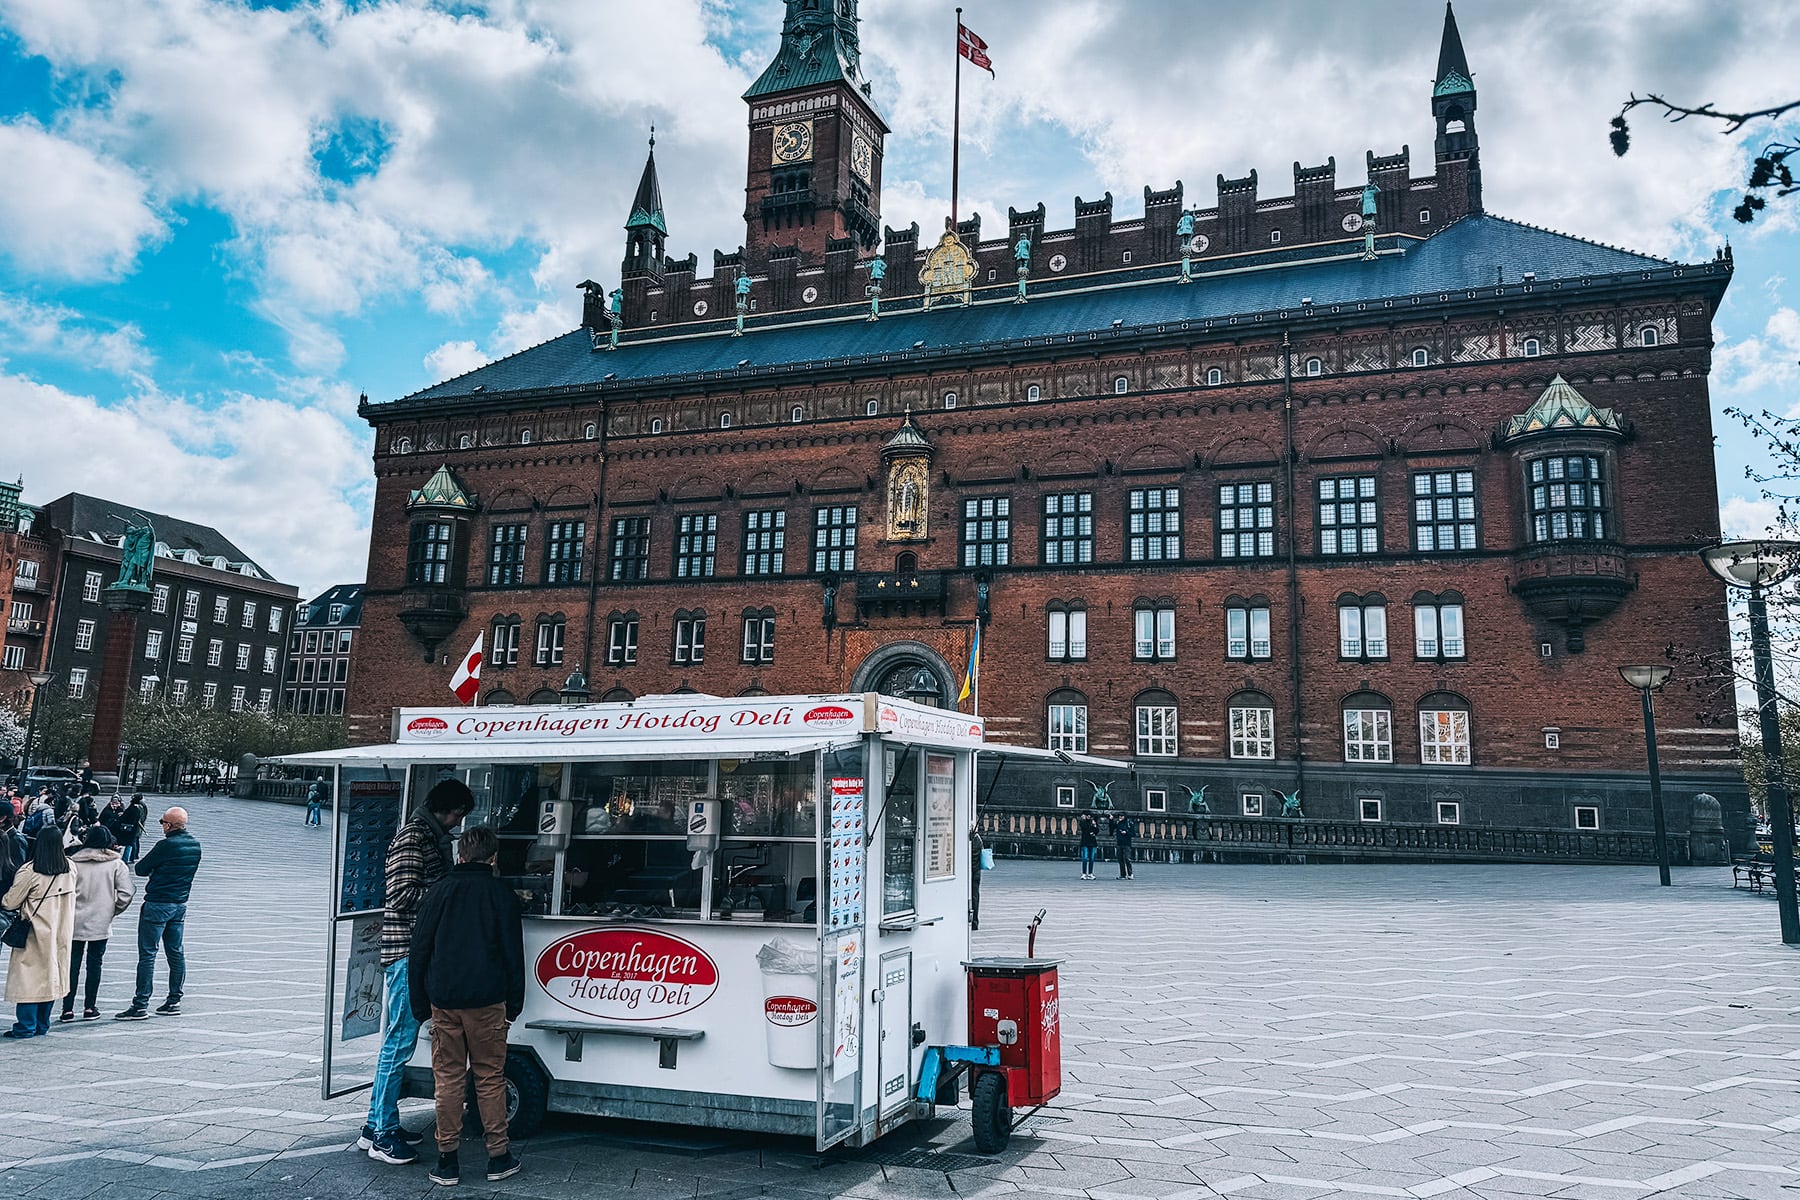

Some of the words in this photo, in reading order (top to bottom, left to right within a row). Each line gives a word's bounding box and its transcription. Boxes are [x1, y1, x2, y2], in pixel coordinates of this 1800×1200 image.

[457, 713, 609, 738] Copenhagen
[616, 709, 722, 733] Hotdog
[729, 706, 793, 727] Deli
[808, 709, 849, 720] Copenhagen
[555, 942, 698, 983] Copenhagen
[611, 971, 622, 979] Est.
[623, 972, 638, 980] 2017
[569, 978, 642, 1010] Hotdog
[648, 983, 692, 1006] Deli
[766, 1001, 811, 1013] Copenhagen
